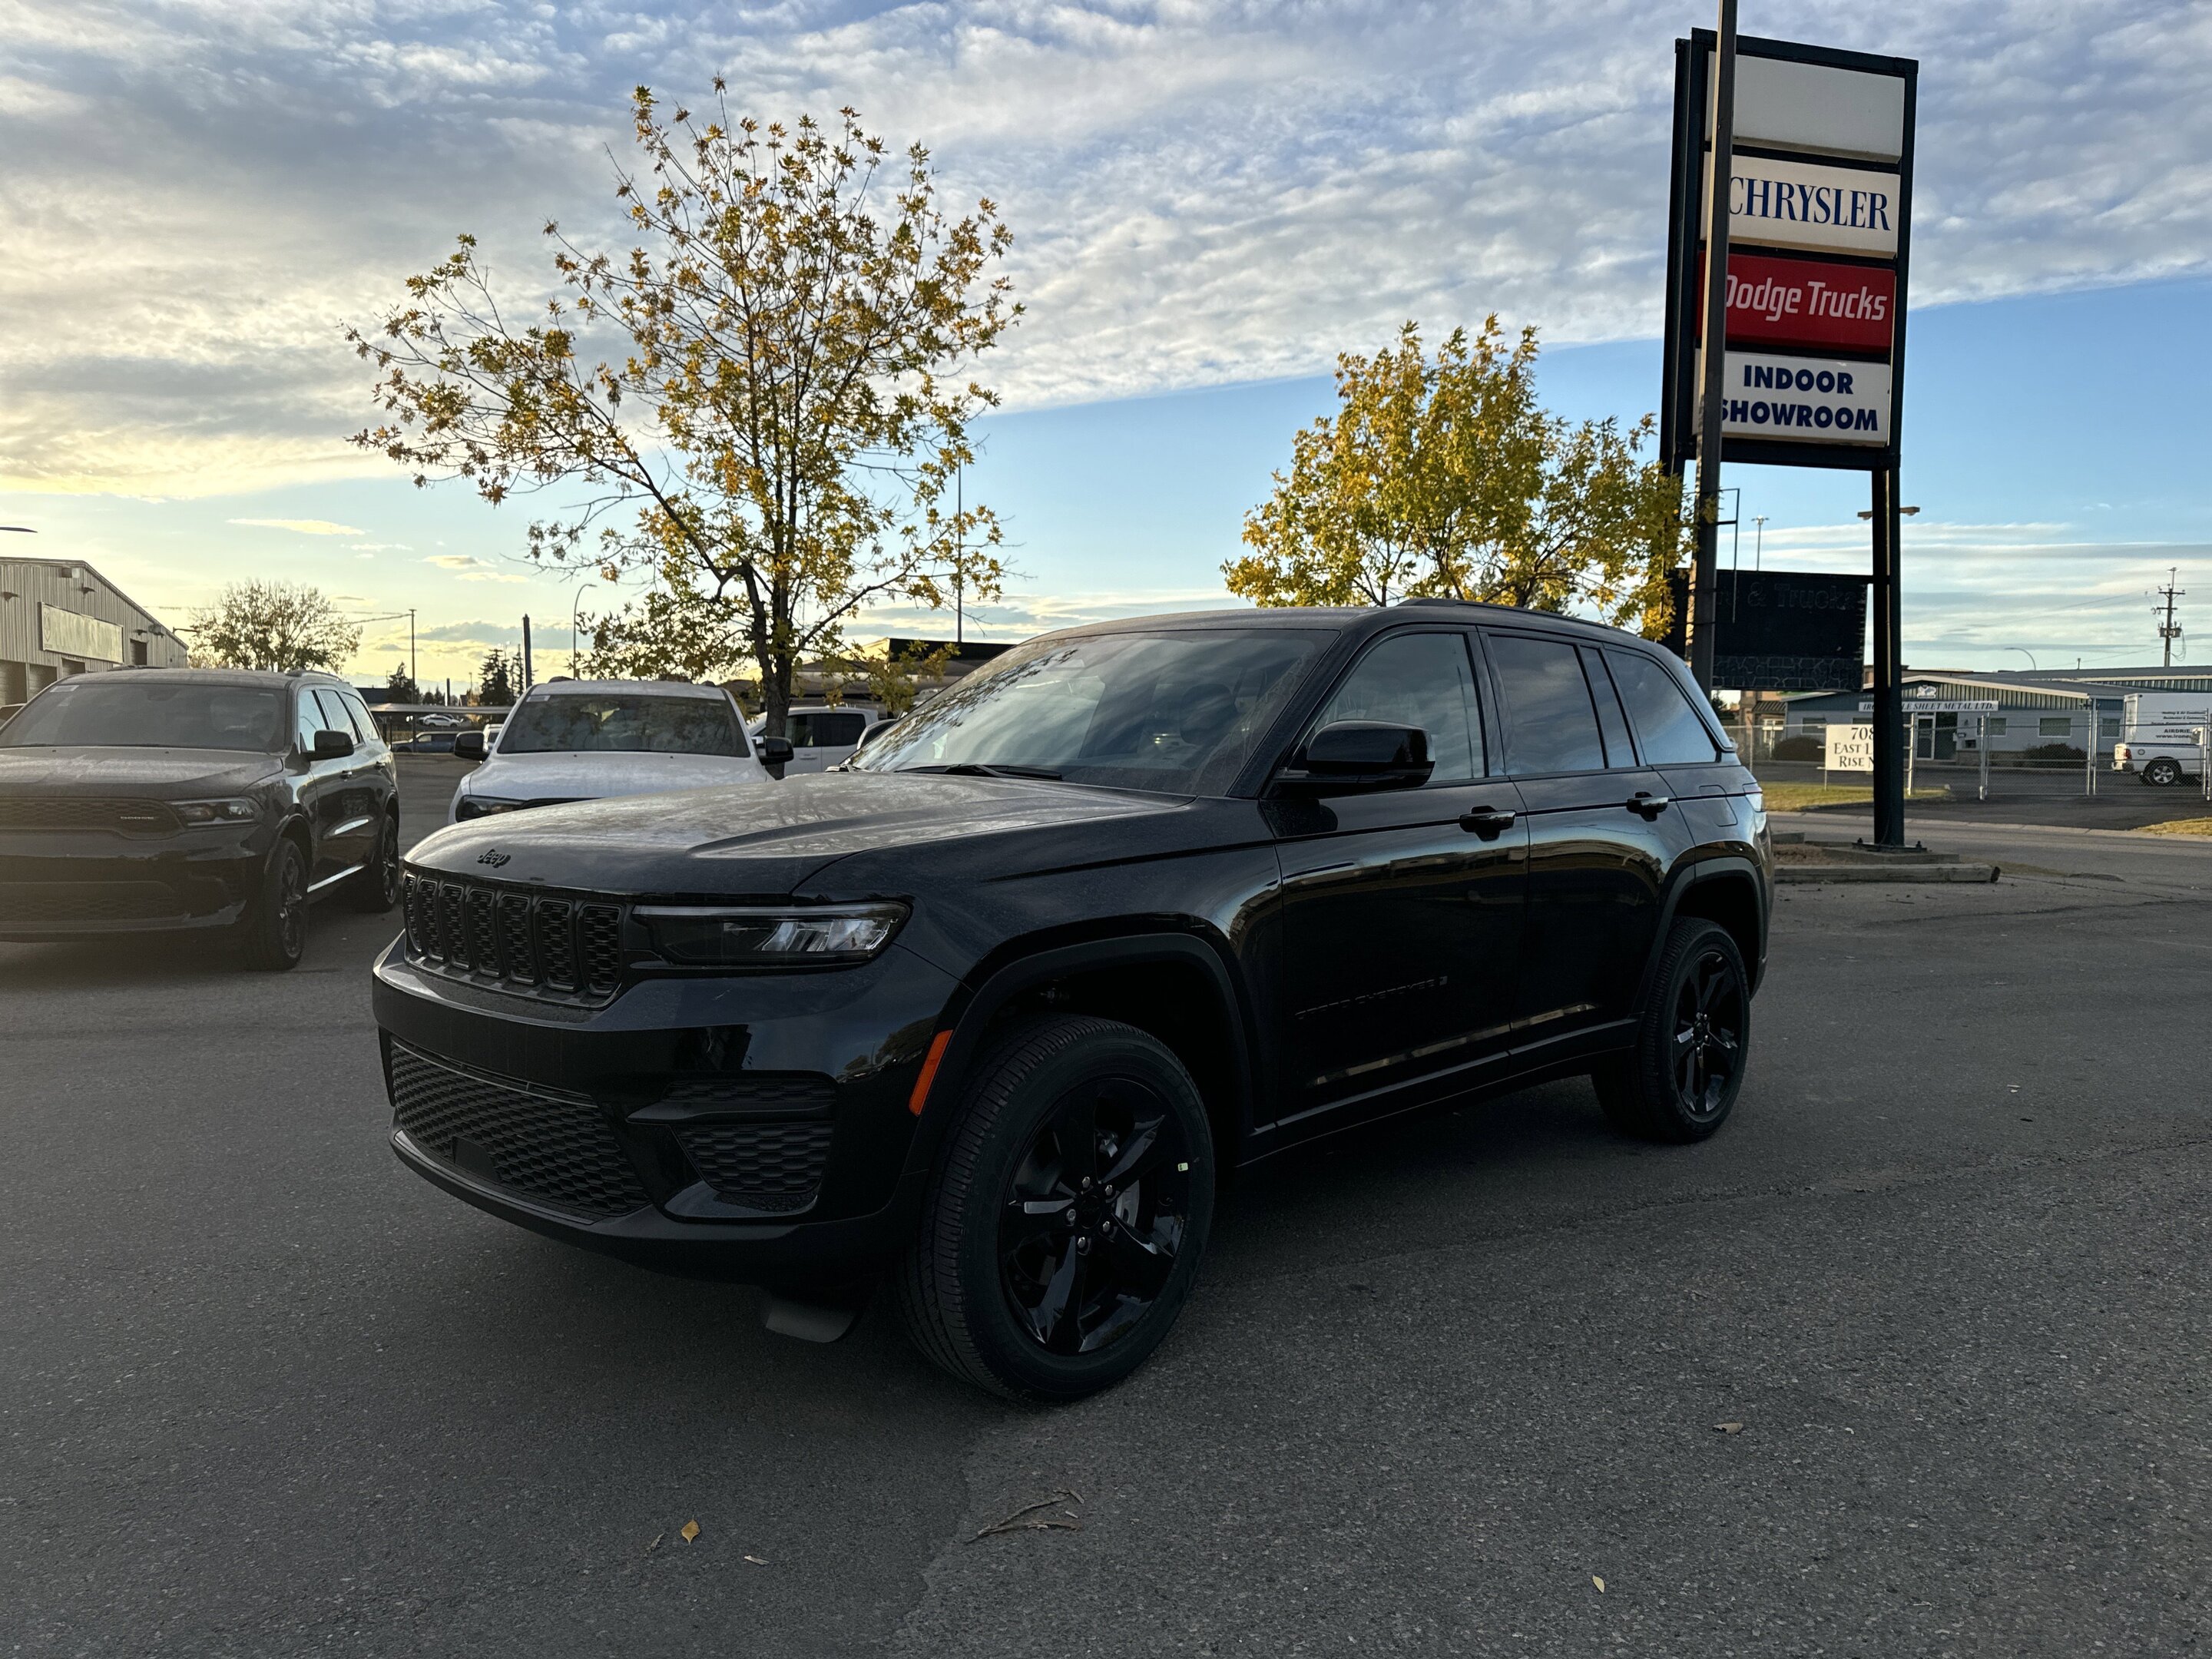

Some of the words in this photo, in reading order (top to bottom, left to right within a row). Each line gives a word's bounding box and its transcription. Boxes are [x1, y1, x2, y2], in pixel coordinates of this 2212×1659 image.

[1729, 176, 1892, 231] CHRYSLER
[1807, 280, 1888, 321] Trucks
[1743, 364, 1854, 395] INDOOR
[477, 849, 512, 869] Jeep
